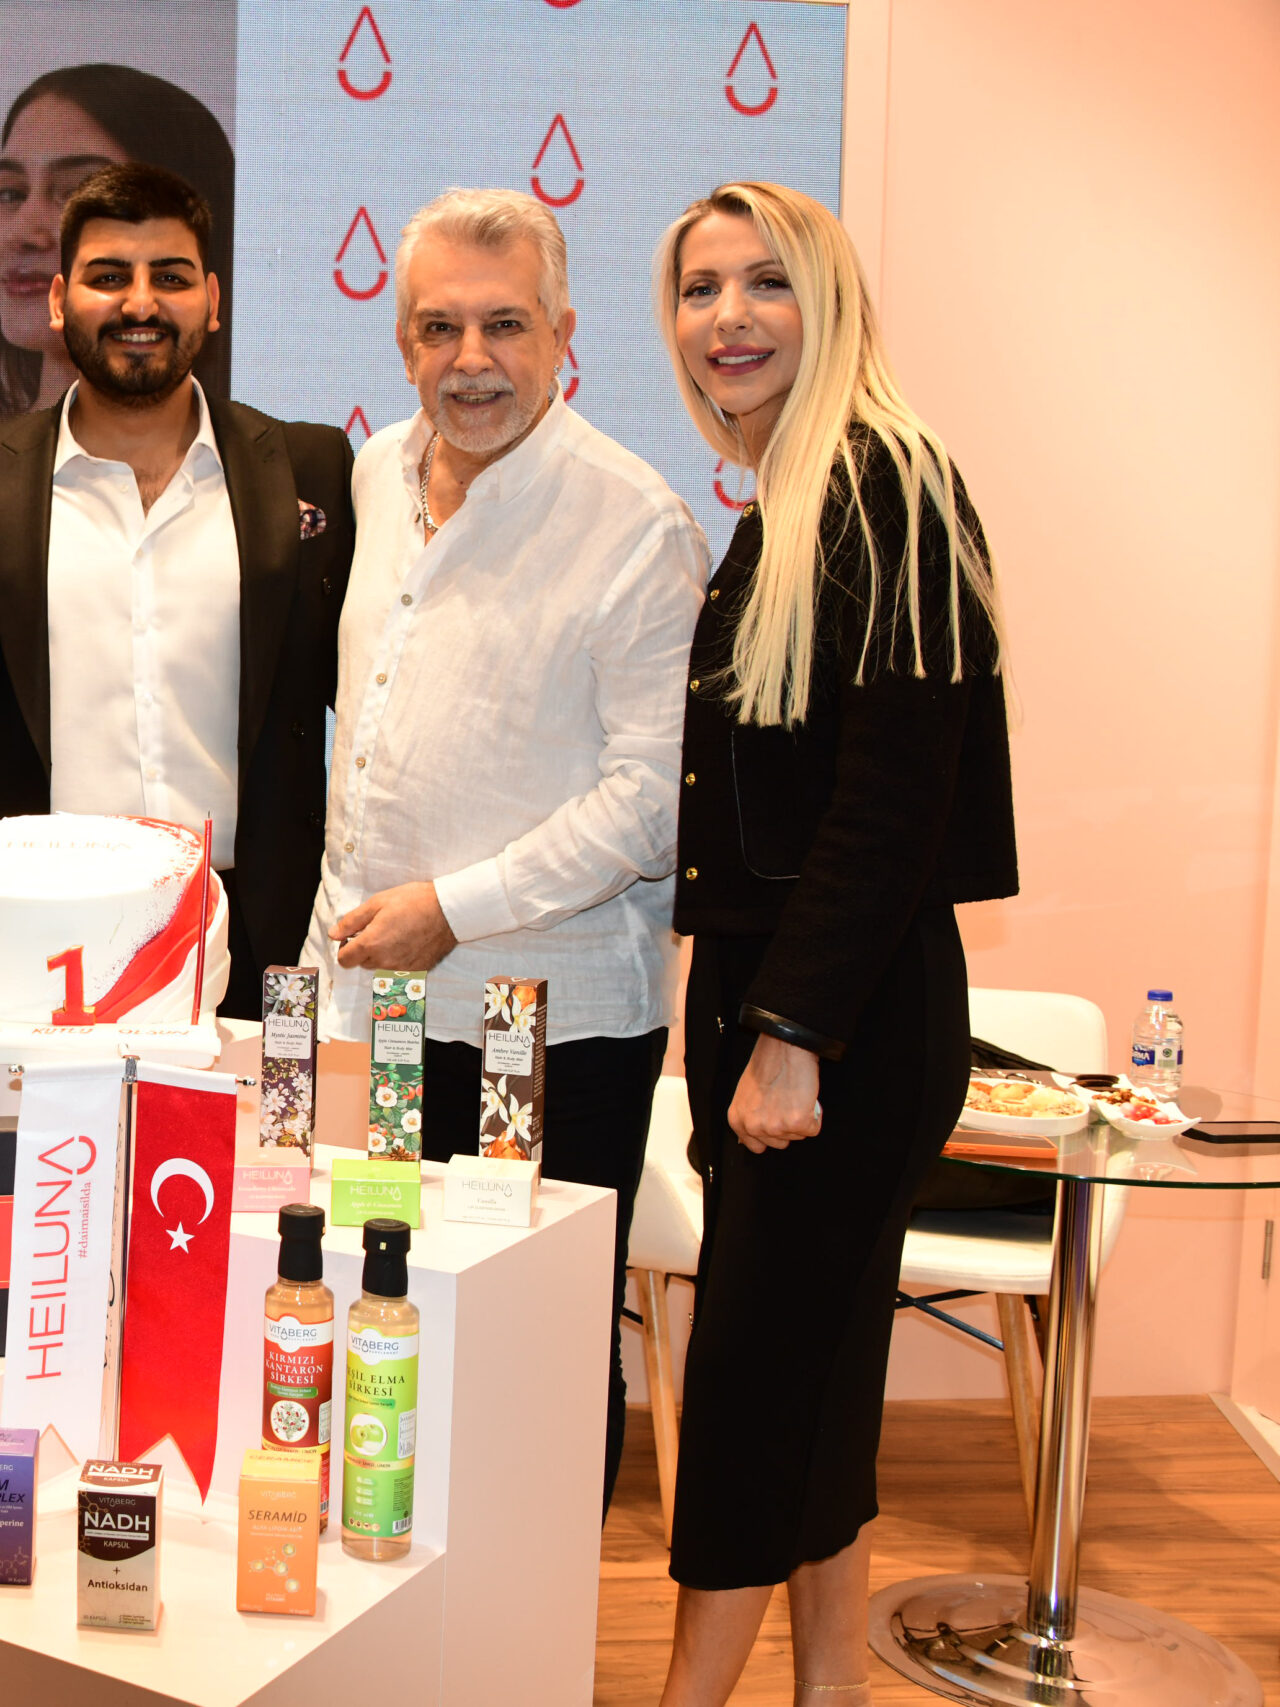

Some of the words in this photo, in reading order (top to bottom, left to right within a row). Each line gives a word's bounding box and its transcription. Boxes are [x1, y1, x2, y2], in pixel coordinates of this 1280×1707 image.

[47, 945, 96, 1026] 1
[268, 1018, 310, 1032] HEILUNA
[377, 1023, 420, 1037] HEILUNA
[488, 1033, 531, 1048] HEILUNA
[242, 1170, 293, 1184] HEILUNA
[350, 1184, 402, 1201] HEILUNA
[462, 1180, 513, 1198] HEILUNA
[26, 1135, 97, 1380] HEILUNA
[269, 1324, 317, 1341] VITABERG
[351, 1335, 399, 1352] VITABERG
[269, 1351, 314, 1365] KIRMIZI
[265, 1358, 324, 1375] KANTARON
[270, 1371, 314, 1385] SİRKESİ
[370, 1374, 405, 1384] ELMA
[89, 1464, 154, 1476] NADH
[99, 1497, 136, 1507] VITABERG
[84, 1511, 150, 1531] NADH
[248, 1509, 307, 1523] SERAMİD
[103, 1540, 130, 1549] KAPSÜL
[88, 1579, 148, 1592] Antioksidan
